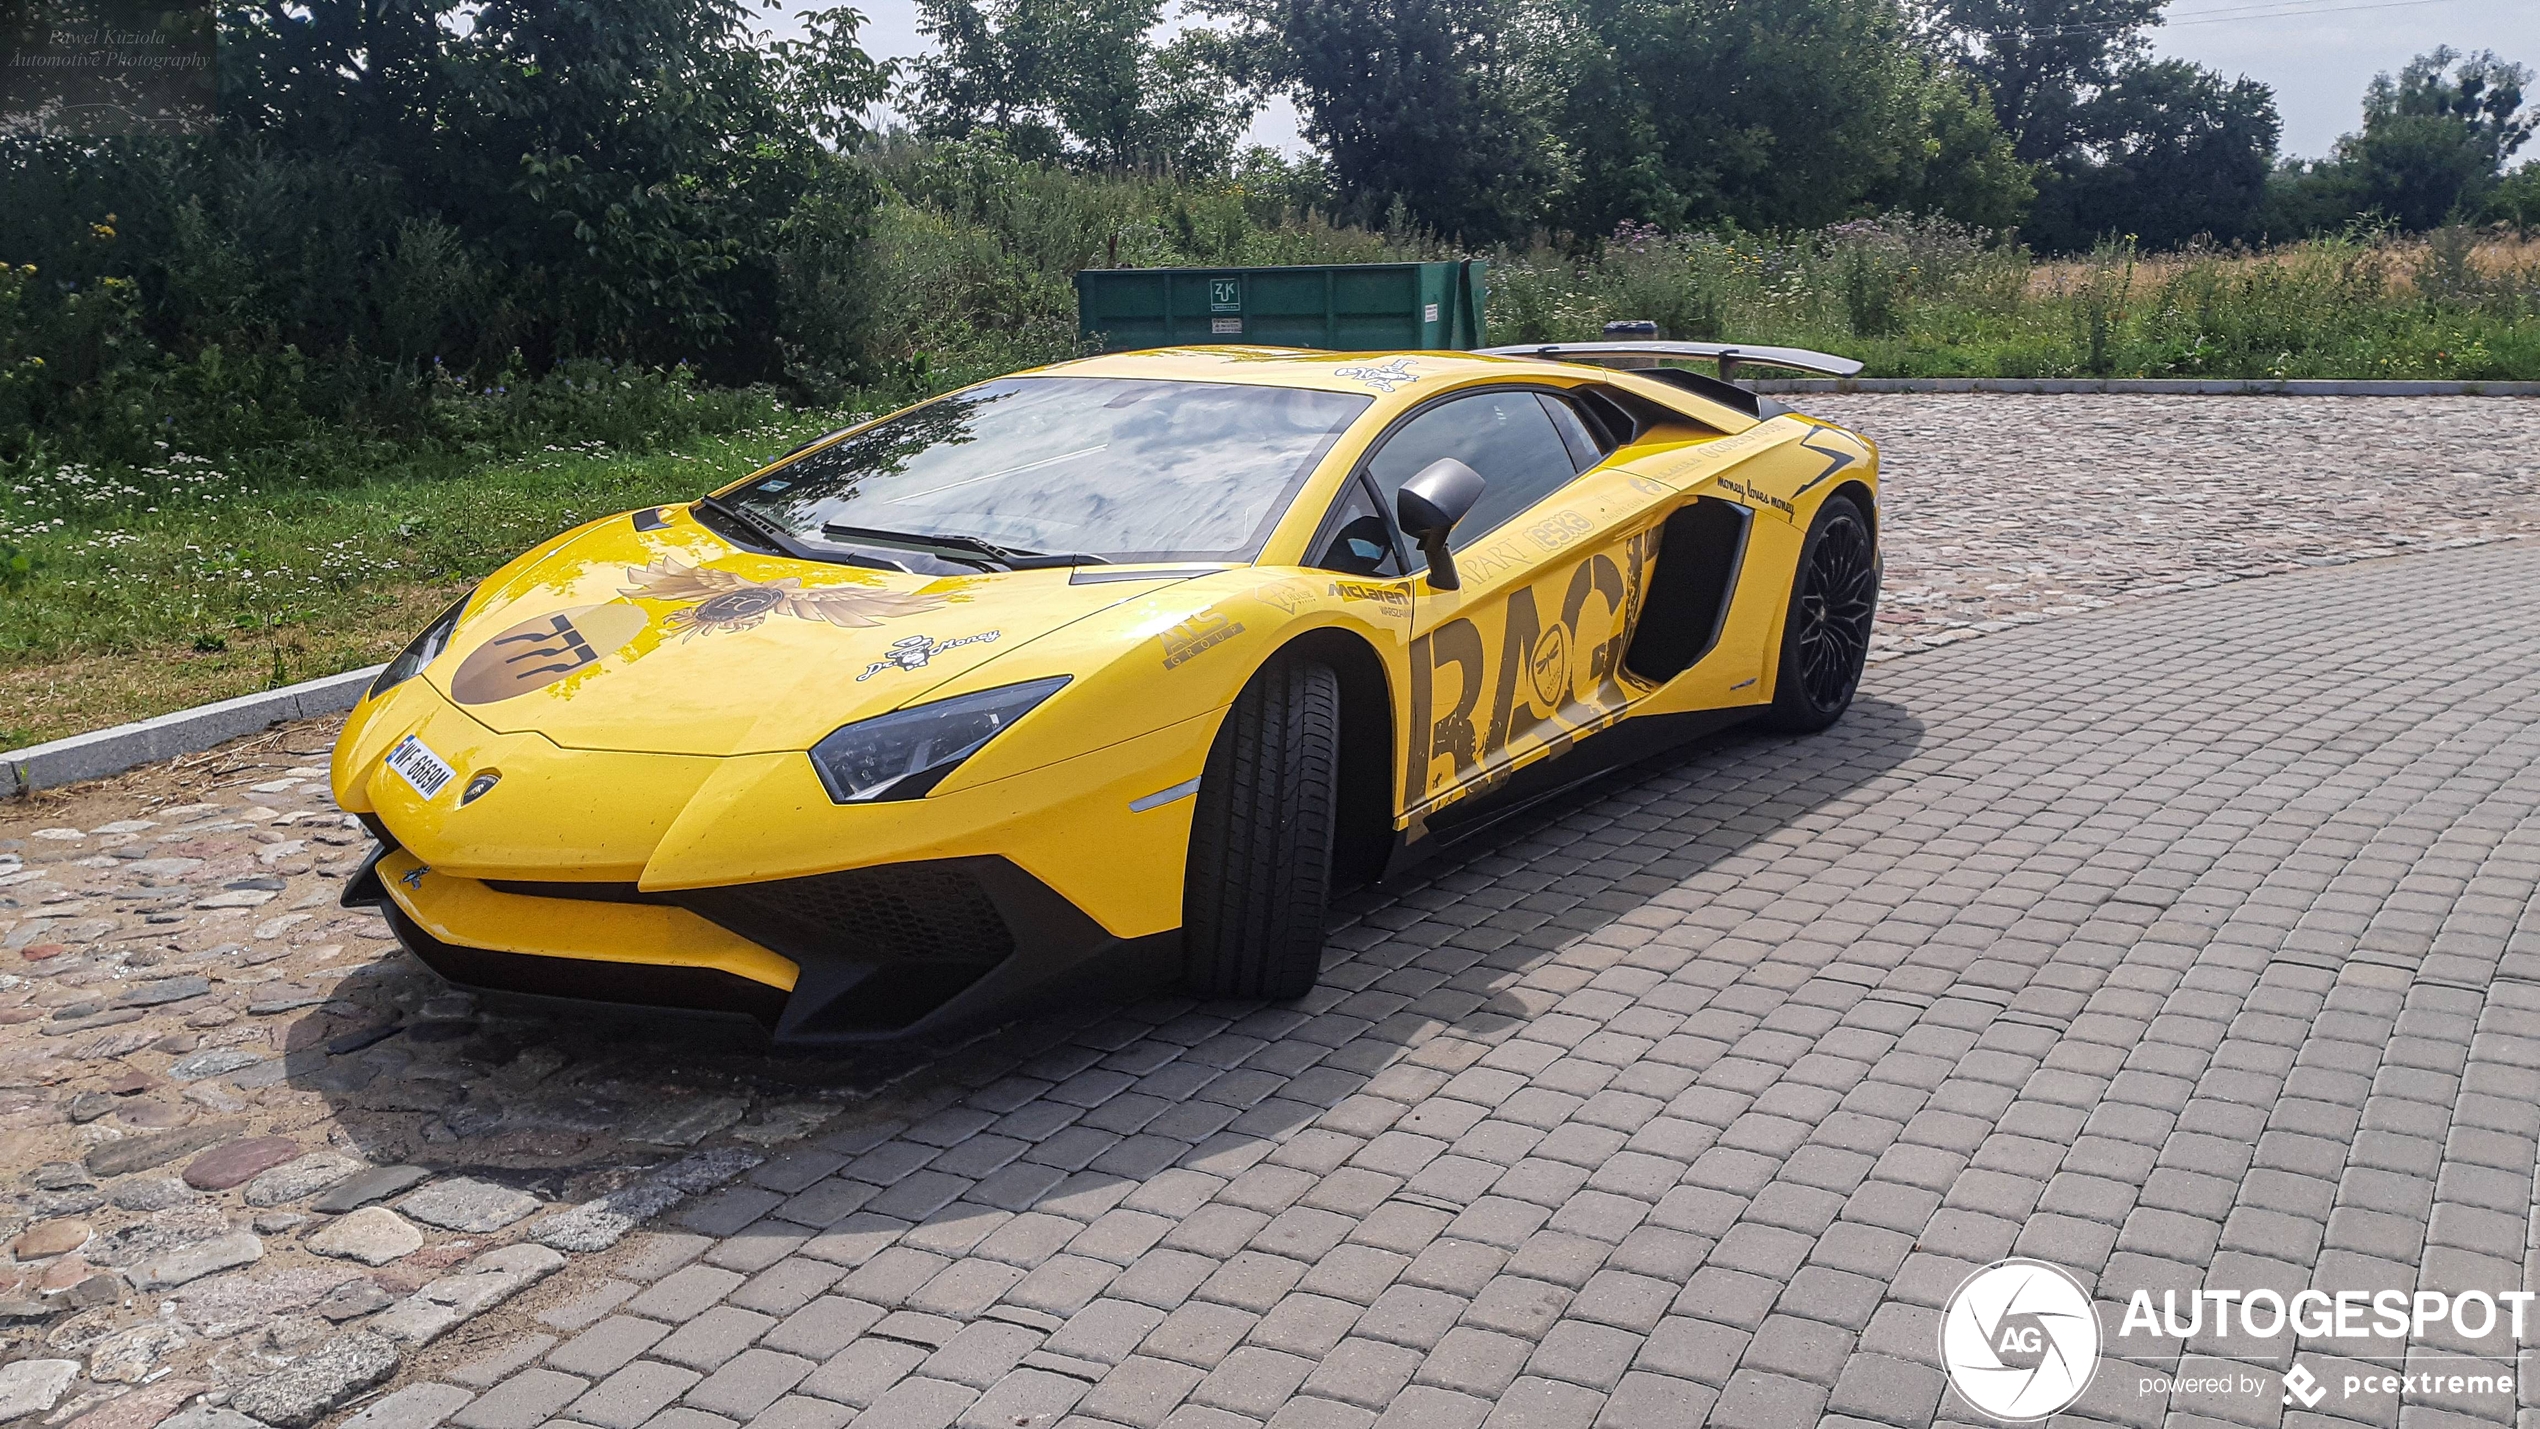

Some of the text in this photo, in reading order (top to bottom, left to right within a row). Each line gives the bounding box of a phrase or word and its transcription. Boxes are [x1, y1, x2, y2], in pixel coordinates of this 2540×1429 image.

[1717, 475, 1795, 523] money loves money
[1460, 537, 1534, 595] APART
[1328, 583, 1411, 606] McLaren
[1170, 626, 1238, 666] GROUP
[393, 741, 451, 796] WF 6669M
